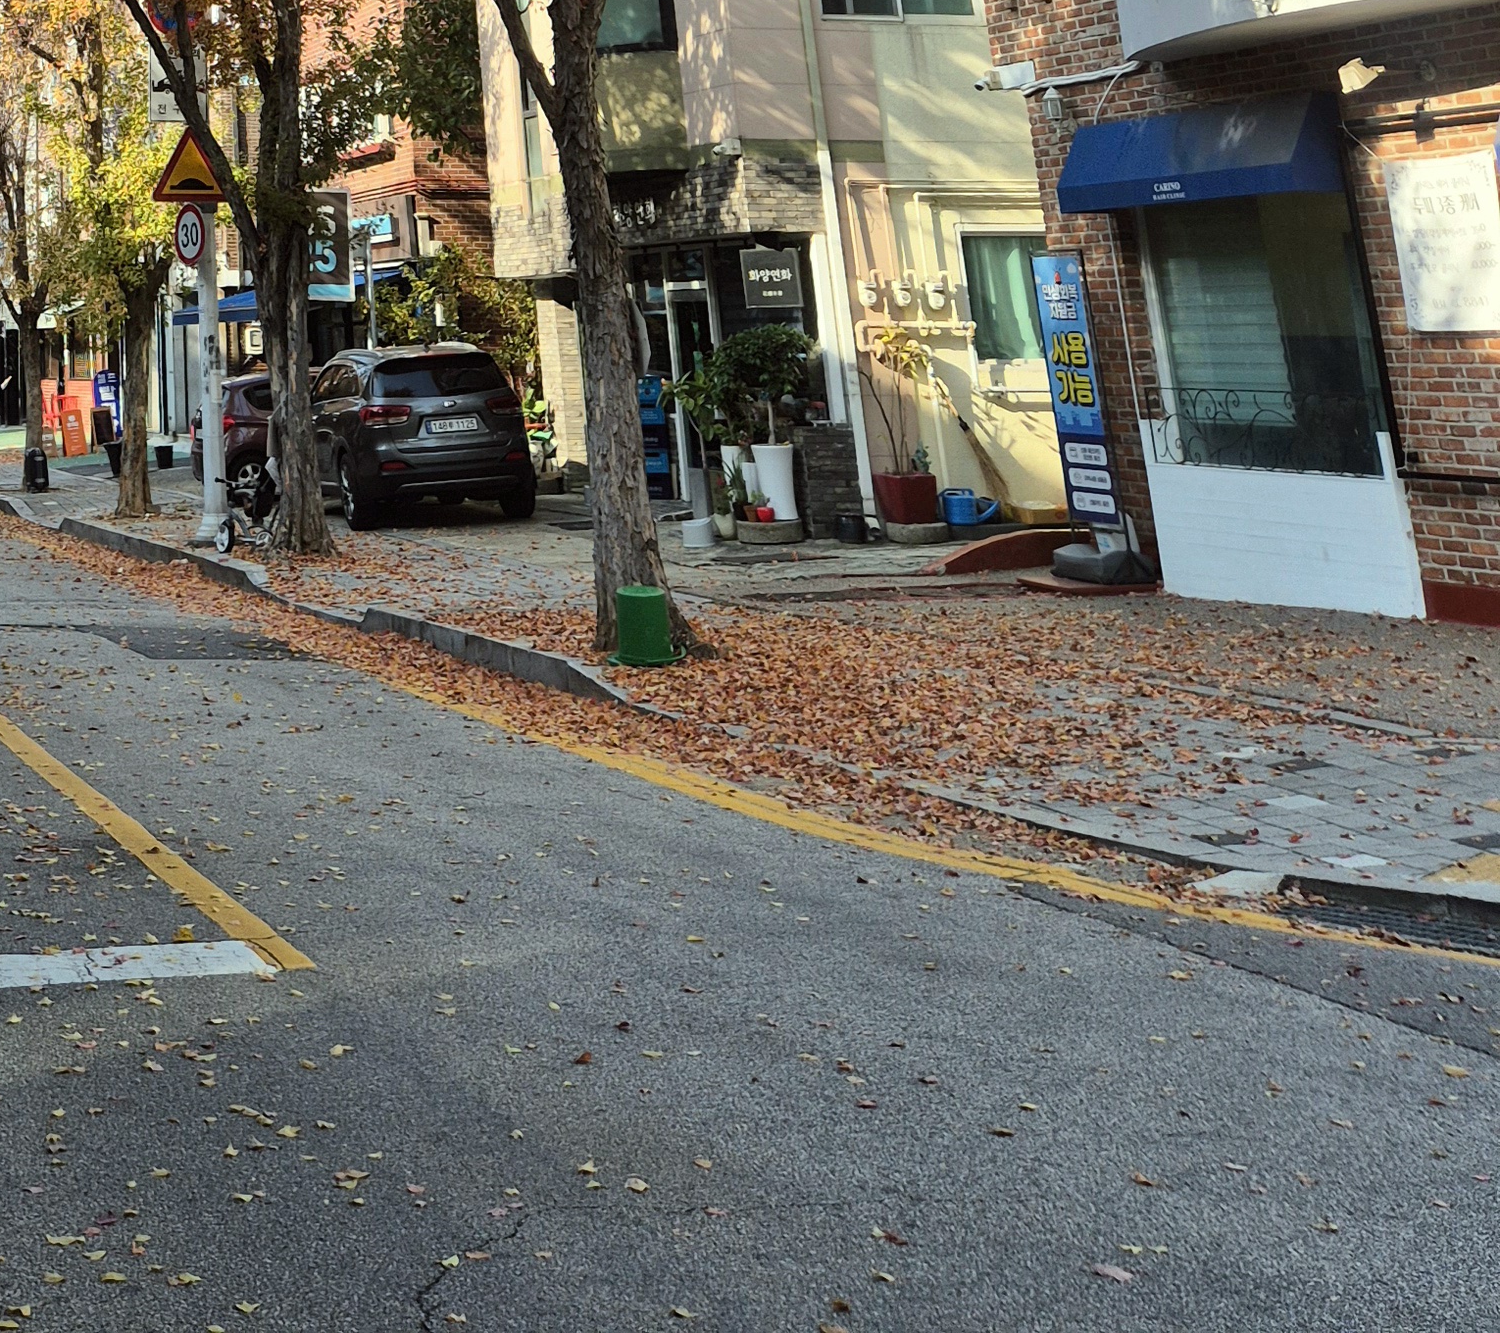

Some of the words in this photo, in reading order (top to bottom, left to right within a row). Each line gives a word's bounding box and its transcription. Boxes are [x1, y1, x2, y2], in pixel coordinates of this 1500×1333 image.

[181, 222, 199, 248] 30
[748, 268, 792, 282] 화양연화
[1041, 283, 1079, 302] 민생회복
[1048, 302, 1077, 320] 지원금
[1052, 332, 1088, 365] 사용
[1055, 369, 1094, 405] 가능
[457, 419, 475, 429] 1125
